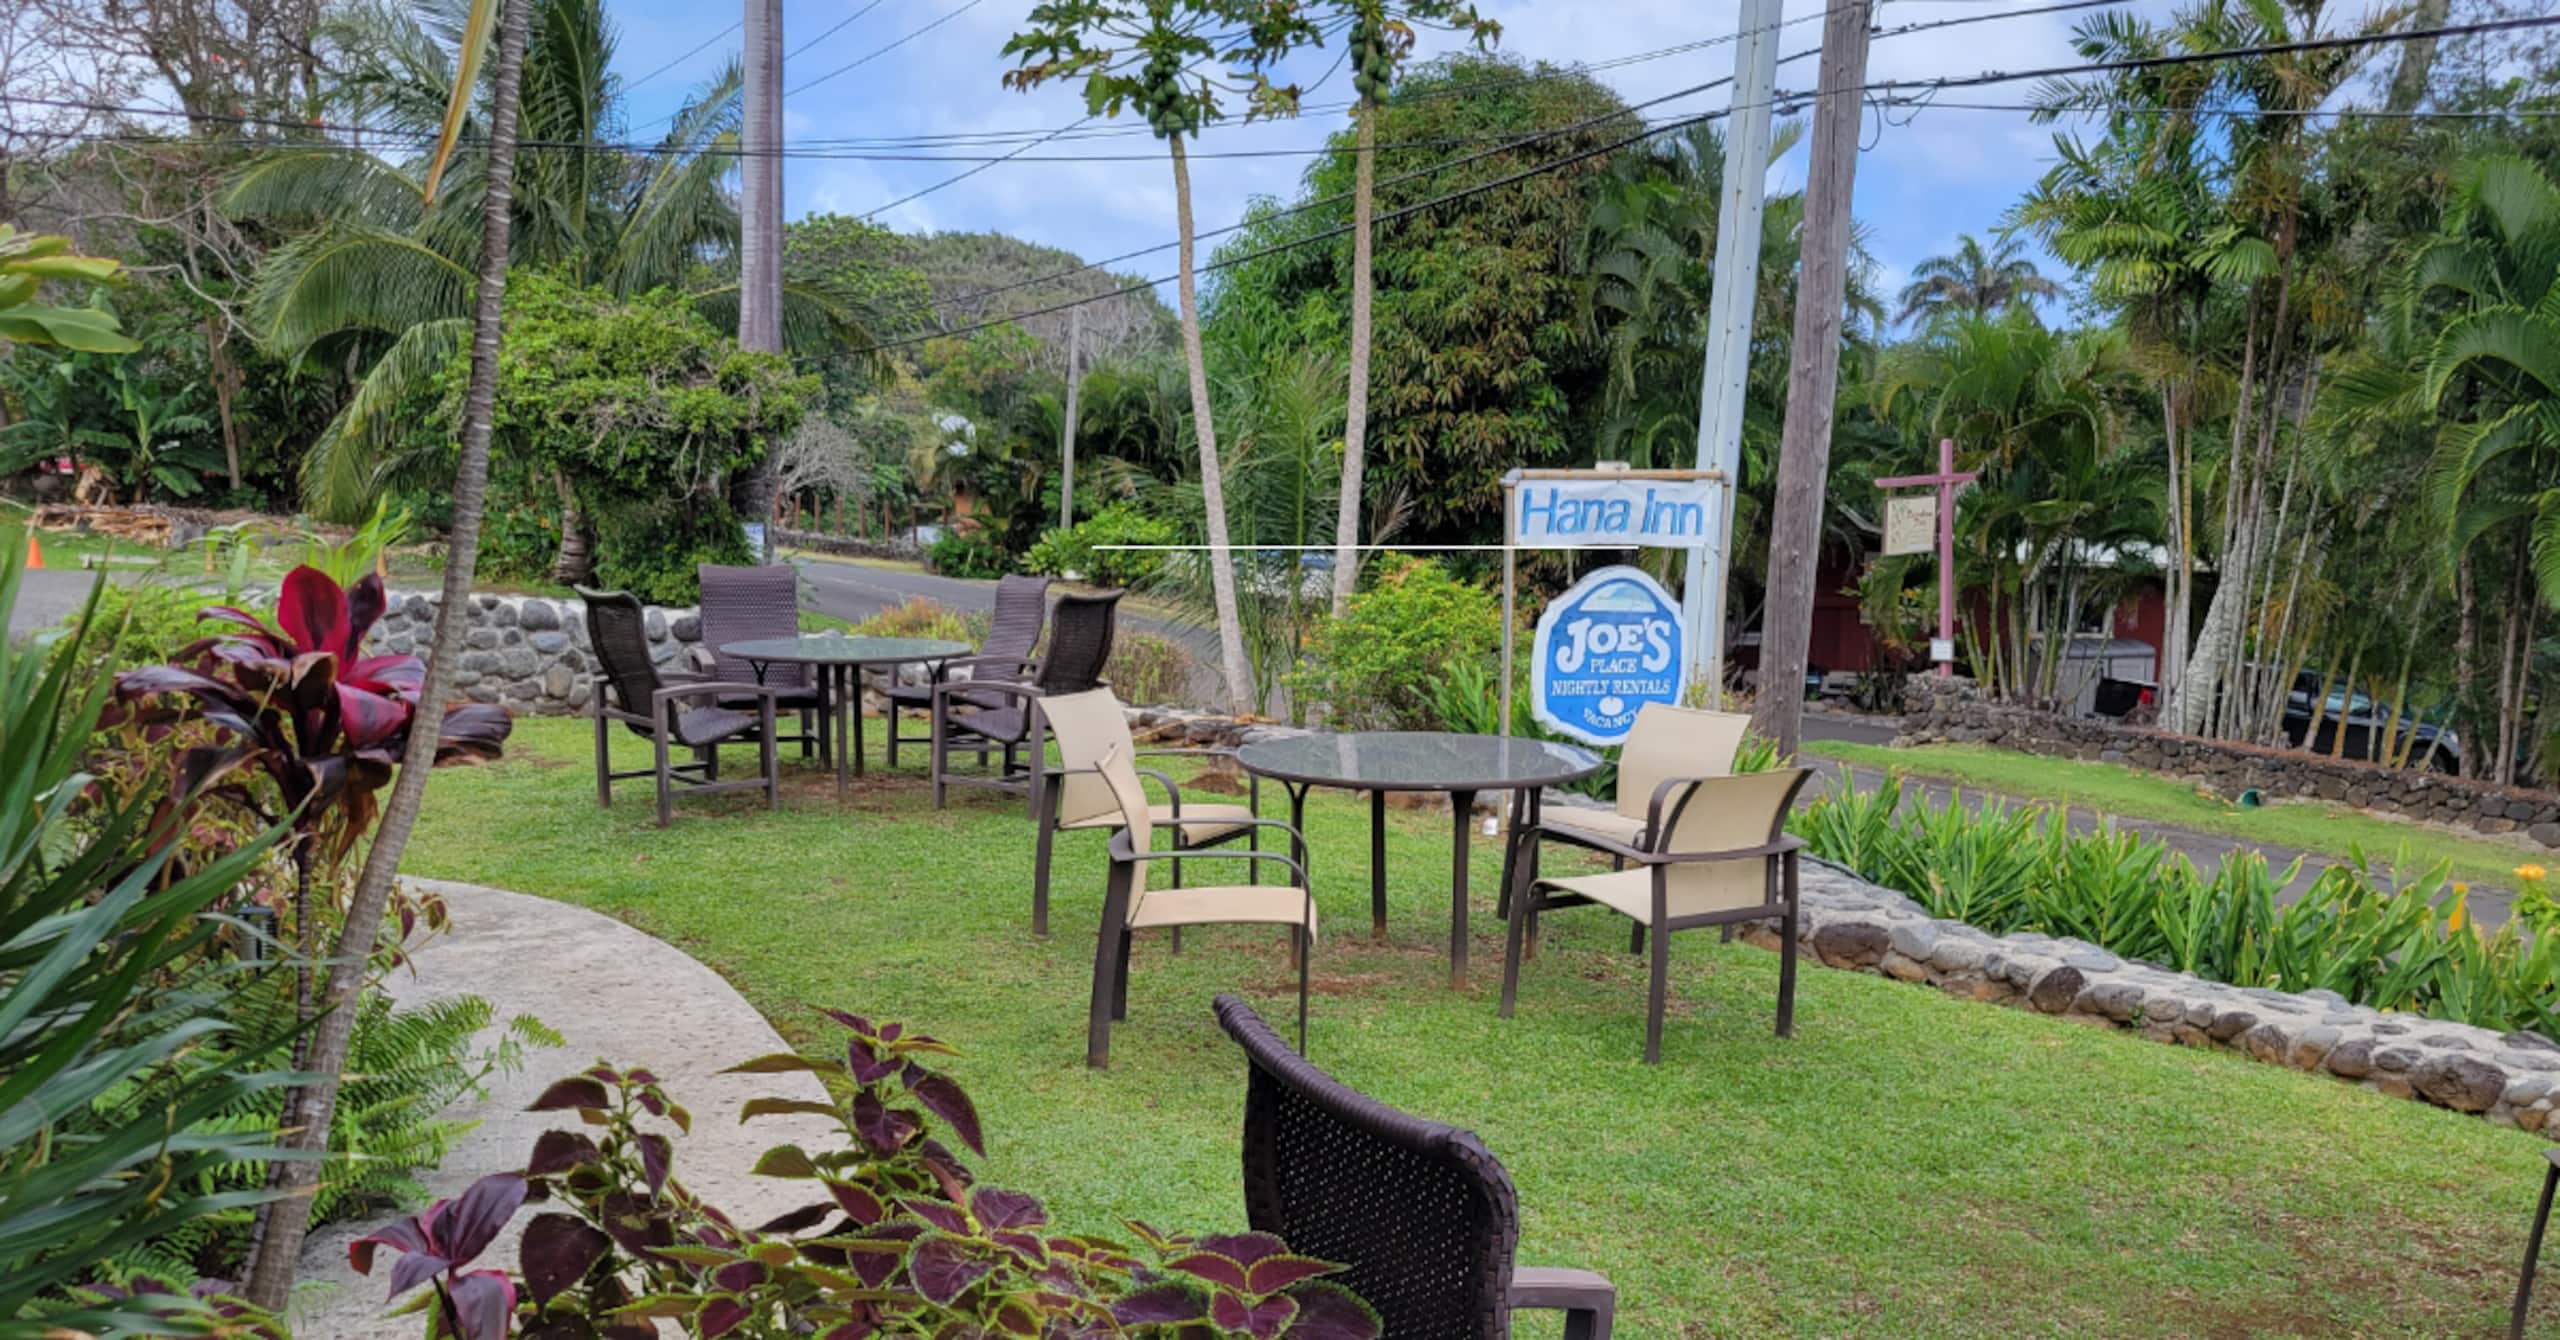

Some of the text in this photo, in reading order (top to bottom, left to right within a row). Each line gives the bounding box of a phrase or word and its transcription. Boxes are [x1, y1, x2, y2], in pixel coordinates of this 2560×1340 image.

[1520, 487, 1704, 536] Hana Inn
[1555, 617, 1671, 674] JOE'S
[1590, 658, 1637, 673] PLACE
[1551, 678, 1671, 696] NIGHTLY RENTALS
